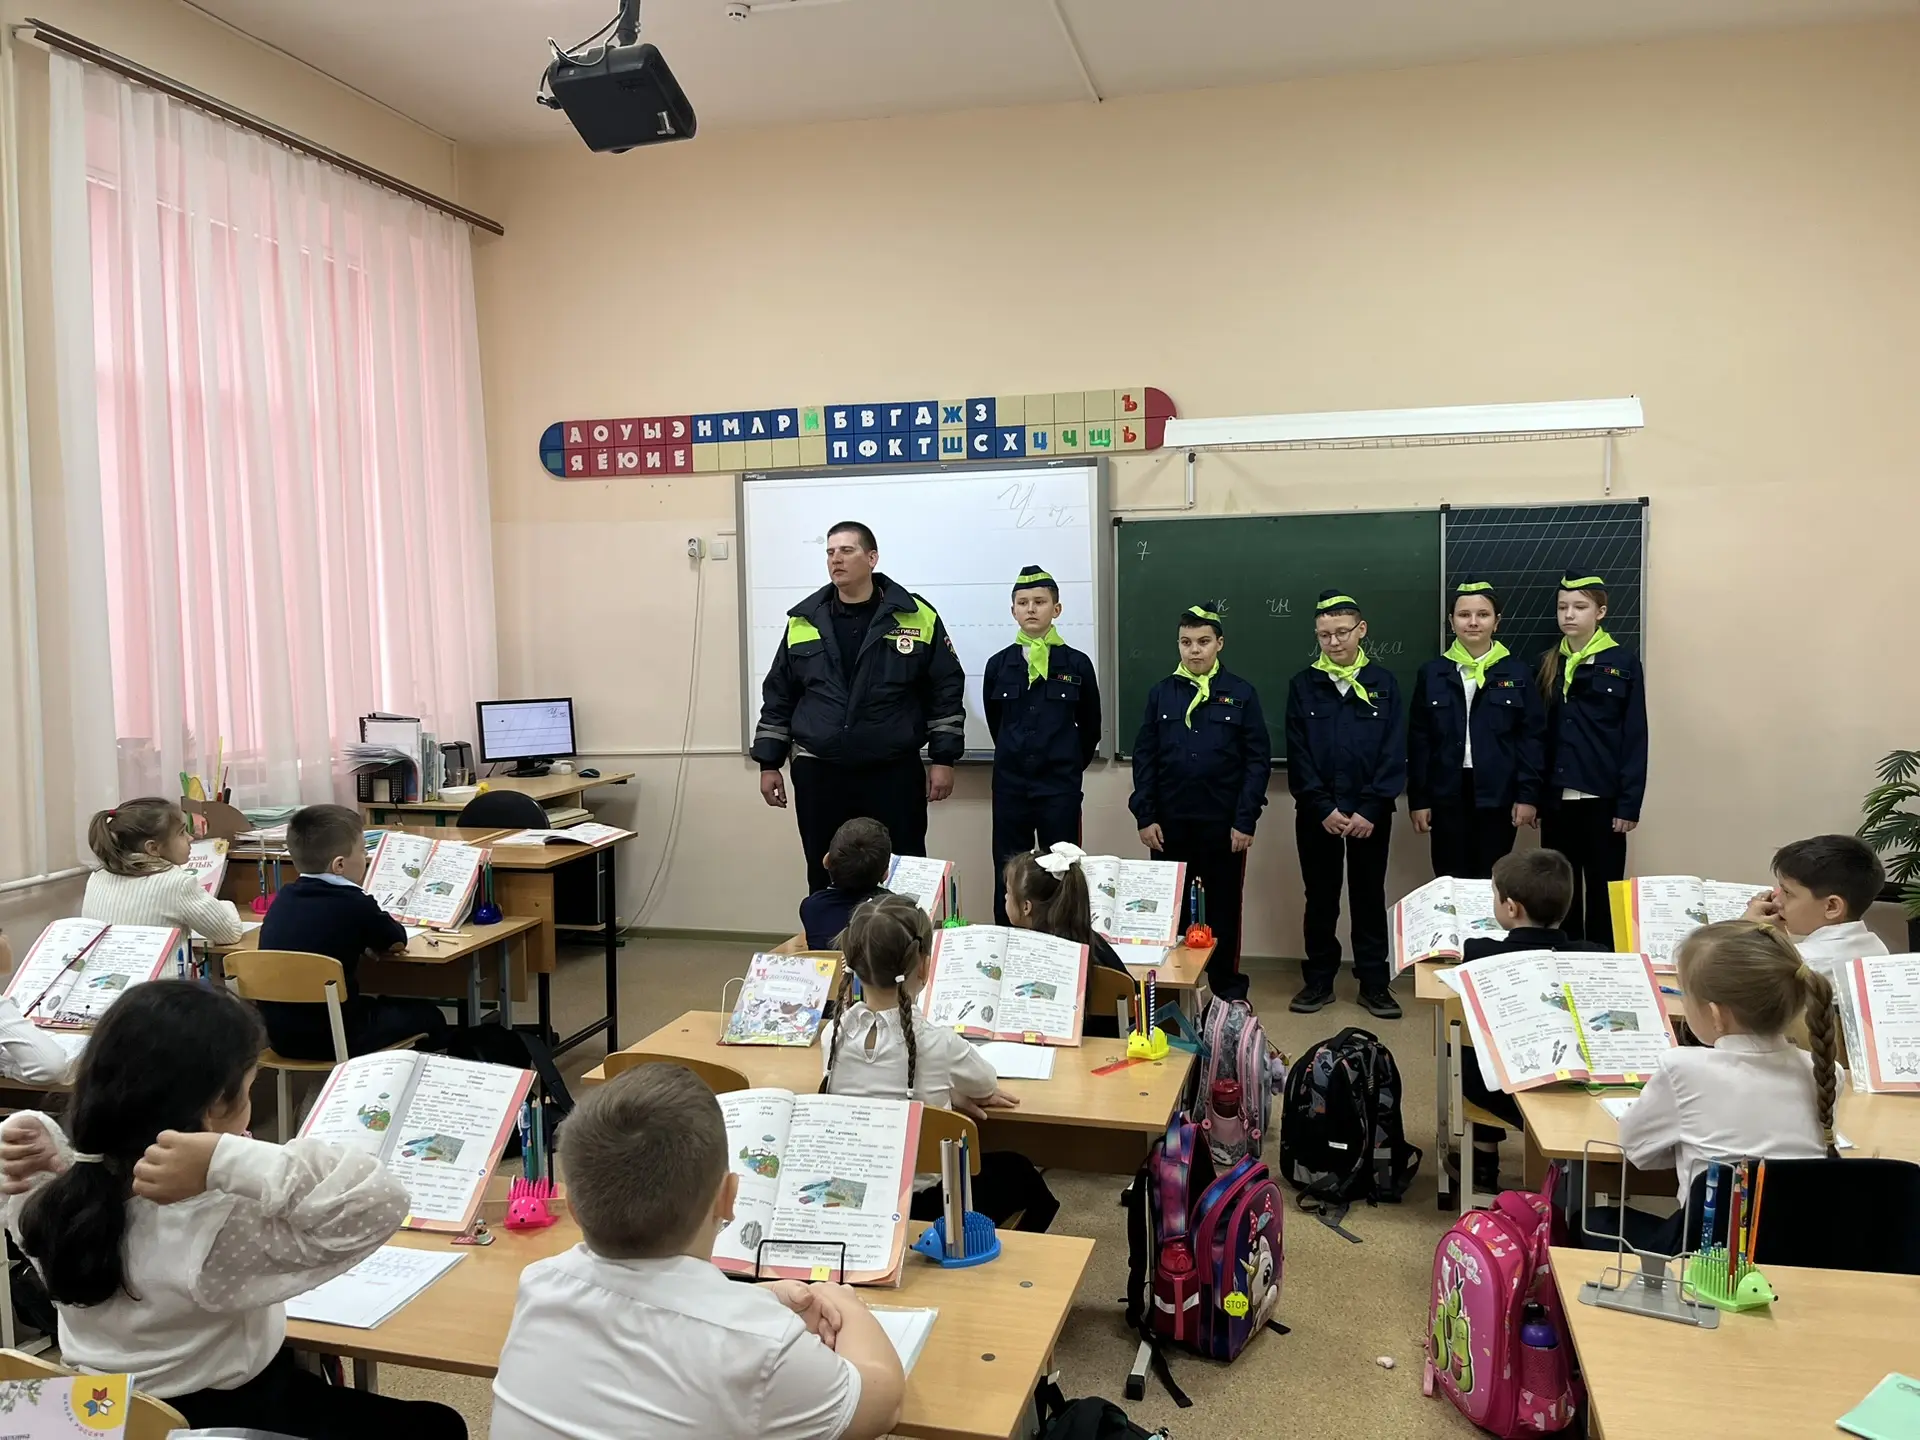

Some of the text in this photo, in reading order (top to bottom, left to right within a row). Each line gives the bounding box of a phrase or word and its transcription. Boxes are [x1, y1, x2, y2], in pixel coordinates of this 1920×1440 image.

[569, 394, 1138, 444] А О У Ы Э Н М Л Р Й Б В Г Д Ж З Ъ
[570, 425, 1138, 471] Я Ё Ю И Е П Ф К Т Ш С Х Ц Ч Щ Ь
[1225, 1299, 1248, 1310] STOP
